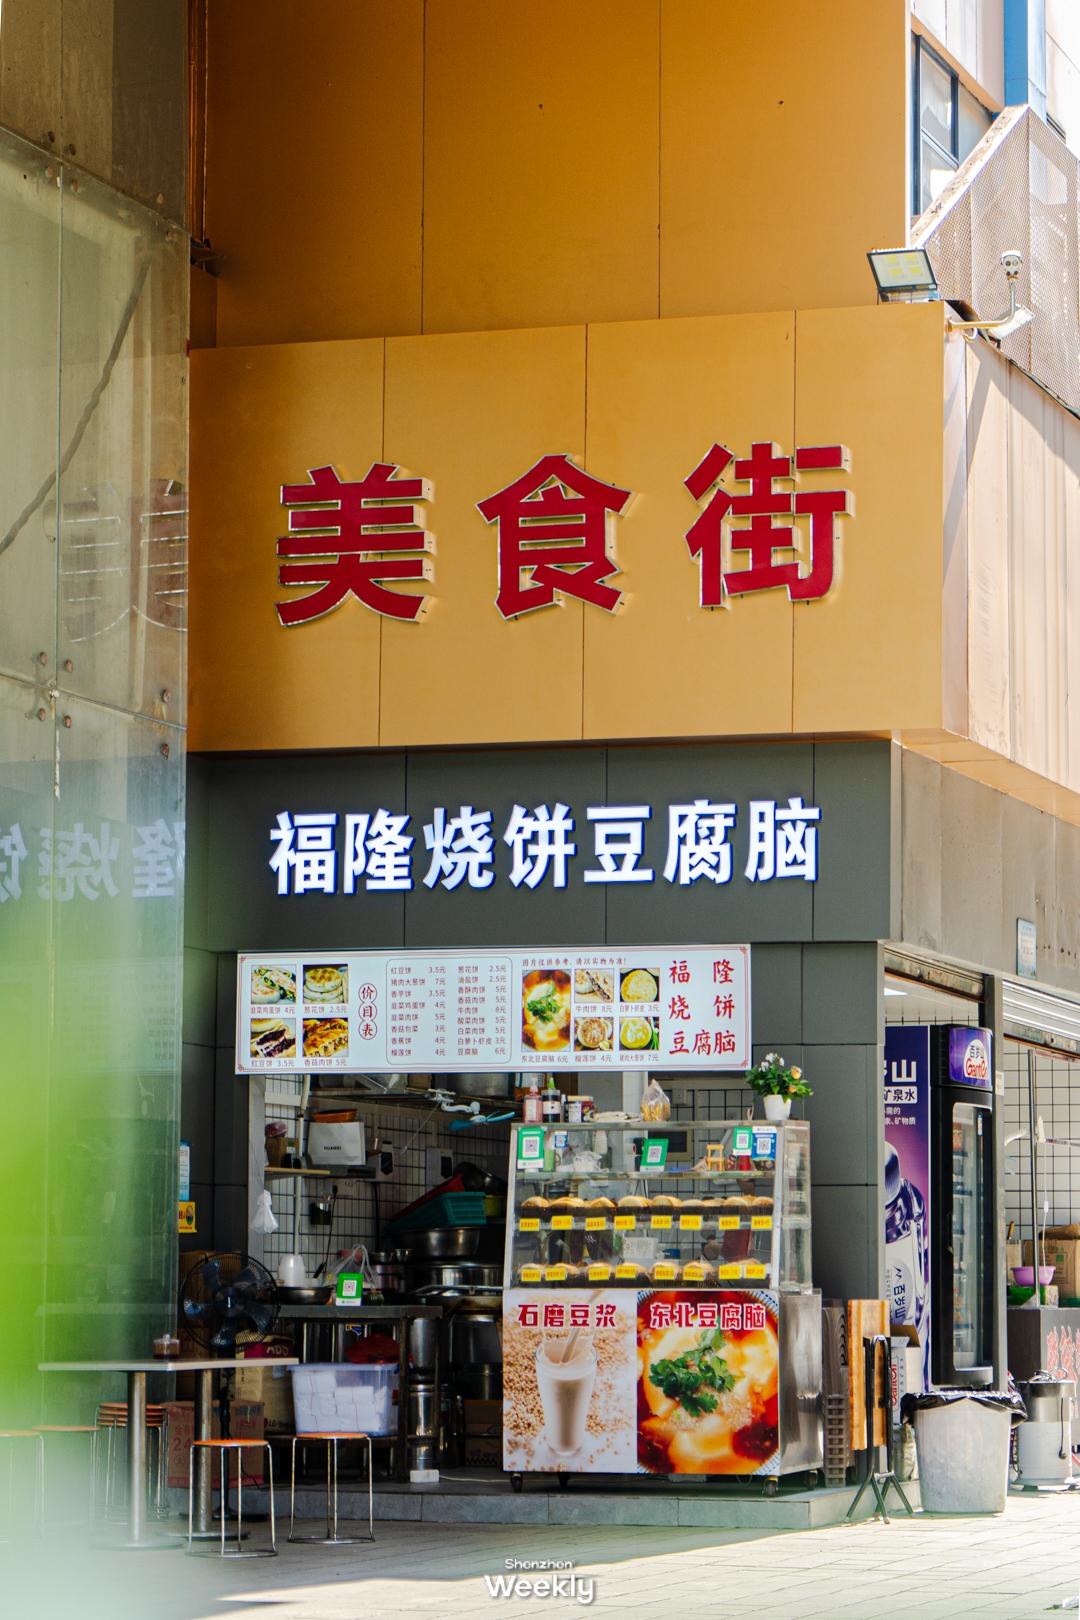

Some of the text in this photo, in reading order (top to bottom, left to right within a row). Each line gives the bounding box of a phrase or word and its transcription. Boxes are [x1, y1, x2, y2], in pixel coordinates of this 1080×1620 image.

[276, 443, 857, 627] 美食街
[268, 797, 820, 896] 福隆烧饼豆腐脑
[361, 985, 374, 1036] 价目表
[669, 1030, 735, 1056] 豆腐脑
[884, 1059, 917, 1083] 山
[517, 1303, 617, 1329] 石磨豆浆
[650, 1302, 767, 1330] 东北豆腐脑
[894, 1284, 906, 1318] 百岁山
